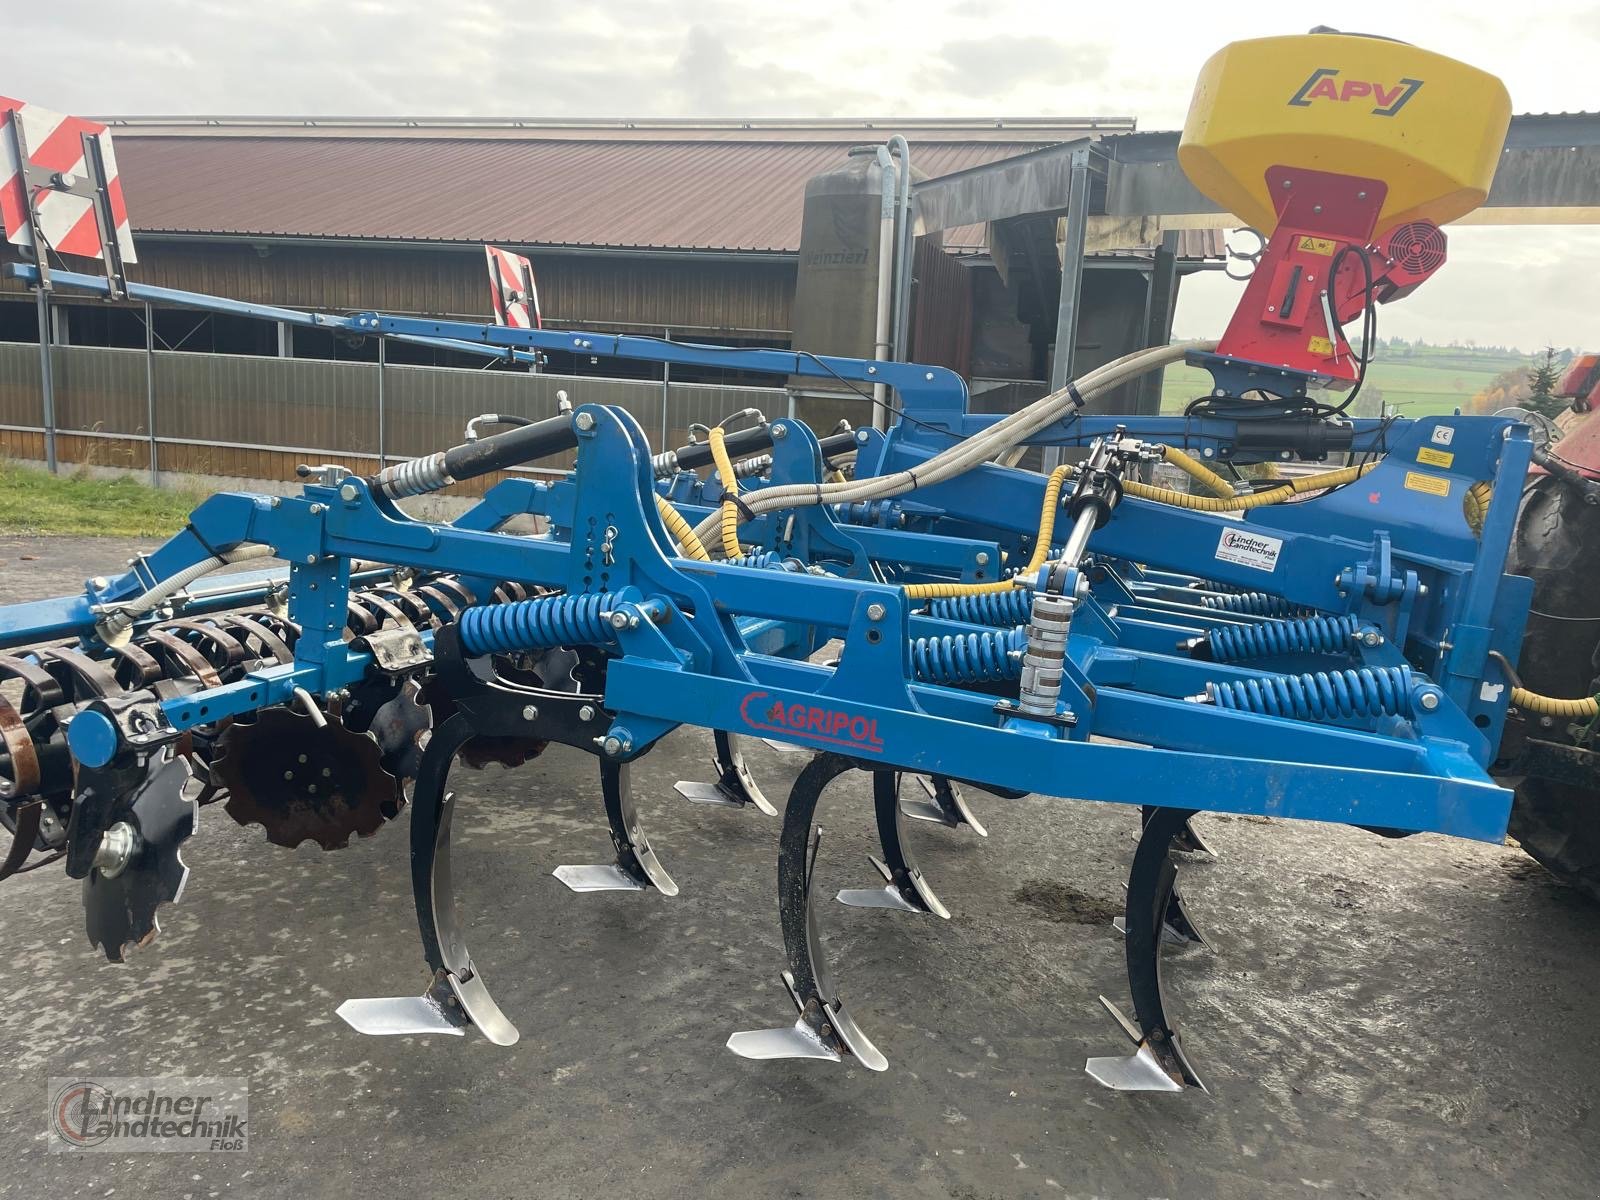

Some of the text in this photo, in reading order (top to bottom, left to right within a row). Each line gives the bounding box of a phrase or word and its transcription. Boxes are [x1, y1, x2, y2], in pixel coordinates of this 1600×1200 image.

[1307, 78, 1405, 107] APV
[1229, 539, 1277, 557] Landtechnik
[1231, 533, 1270, 549] Lindner
